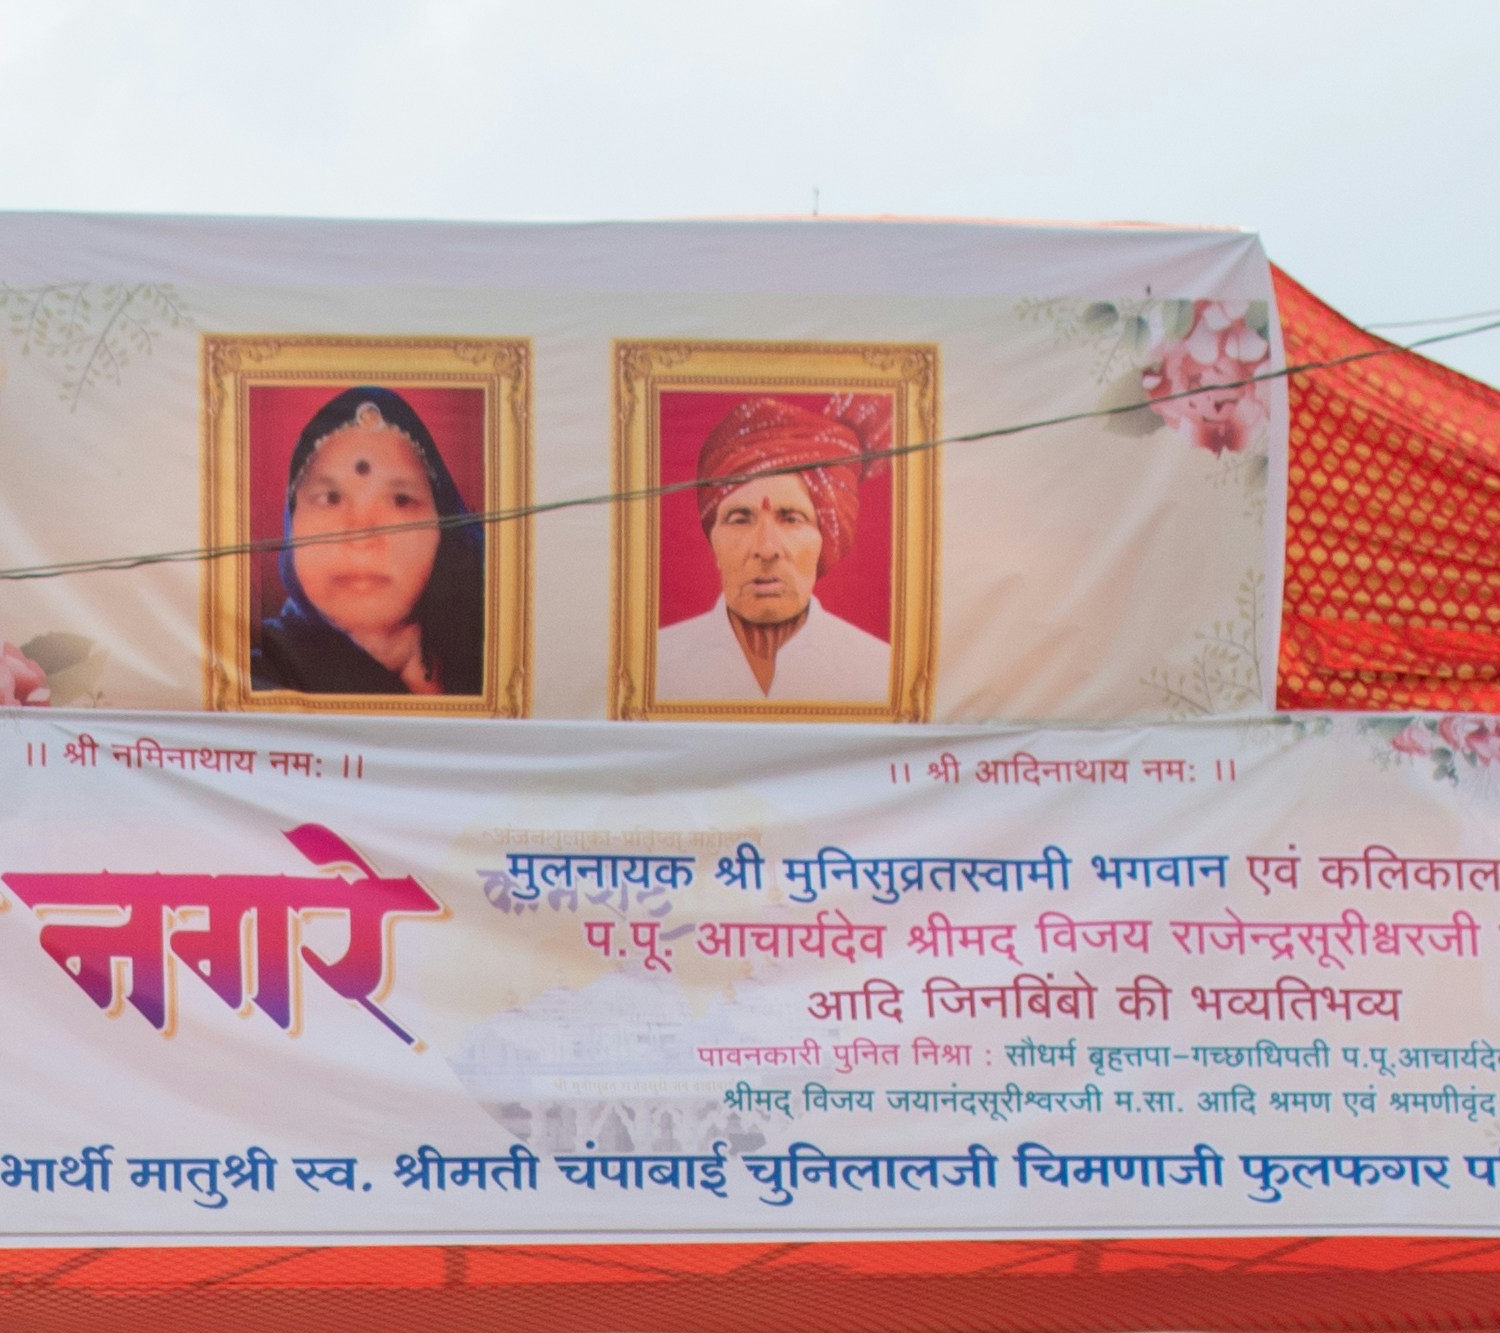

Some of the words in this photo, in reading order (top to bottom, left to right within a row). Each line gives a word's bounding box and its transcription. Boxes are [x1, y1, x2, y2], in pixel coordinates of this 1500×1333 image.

[62, 734, 98, 769] श्री
[111, 736, 256, 775] नमिनाथाय
[926, 752, 962, 786] श्री
[974, 751, 1129, 787] आदिनाथाय
[506, 851, 696, 903] मुलनायक
[714, 841, 765, 893] श्री
[782, 843, 1073, 906] मुनिसुव्रतस्वामी
[1091, 853, 1230, 892] भगवान
[1247, 843, 1301, 895] एवं
[1, 822, 454, 1054] नगरे
[696, 908, 888, 962] आचार्यदेव
[906, 910, 1021, 970] श्रीमद्
[1037, 911, 1151, 956] विजय
[806, 976, 904, 1025] आदि
[922, 969, 1098, 1024] जिनबिंबो
[1118, 974, 1171, 1023] की
[1191, 976, 1404, 1024] भव्यतिभव्य
[698, 1036, 821, 1069] पावनकारी
[832, 1038, 900, 1076] पुनित
[1004, 1035, 1076, 1070] सौधर्म
[804, 1084, 873, 1116] विजय
[1113, 1090, 1185, 1115] म.सा.
[1196, 1084, 1257, 1116] आदि
[1269, 1090, 1332, 1115] श्रमण
[1341, 1082, 1376, 1115] एवं
[126, 1145, 276, 1209] मातुश्री
[291, 1156, 374, 1194] स्व.
[394, 1144, 540, 1193] श्रीमती
[555, 1140, 729, 1197] चंपाबाई
[743, 1141, 999, 1206] चुनिलालजी
[1010, 1141, 1225, 1192] चिमणाजी
